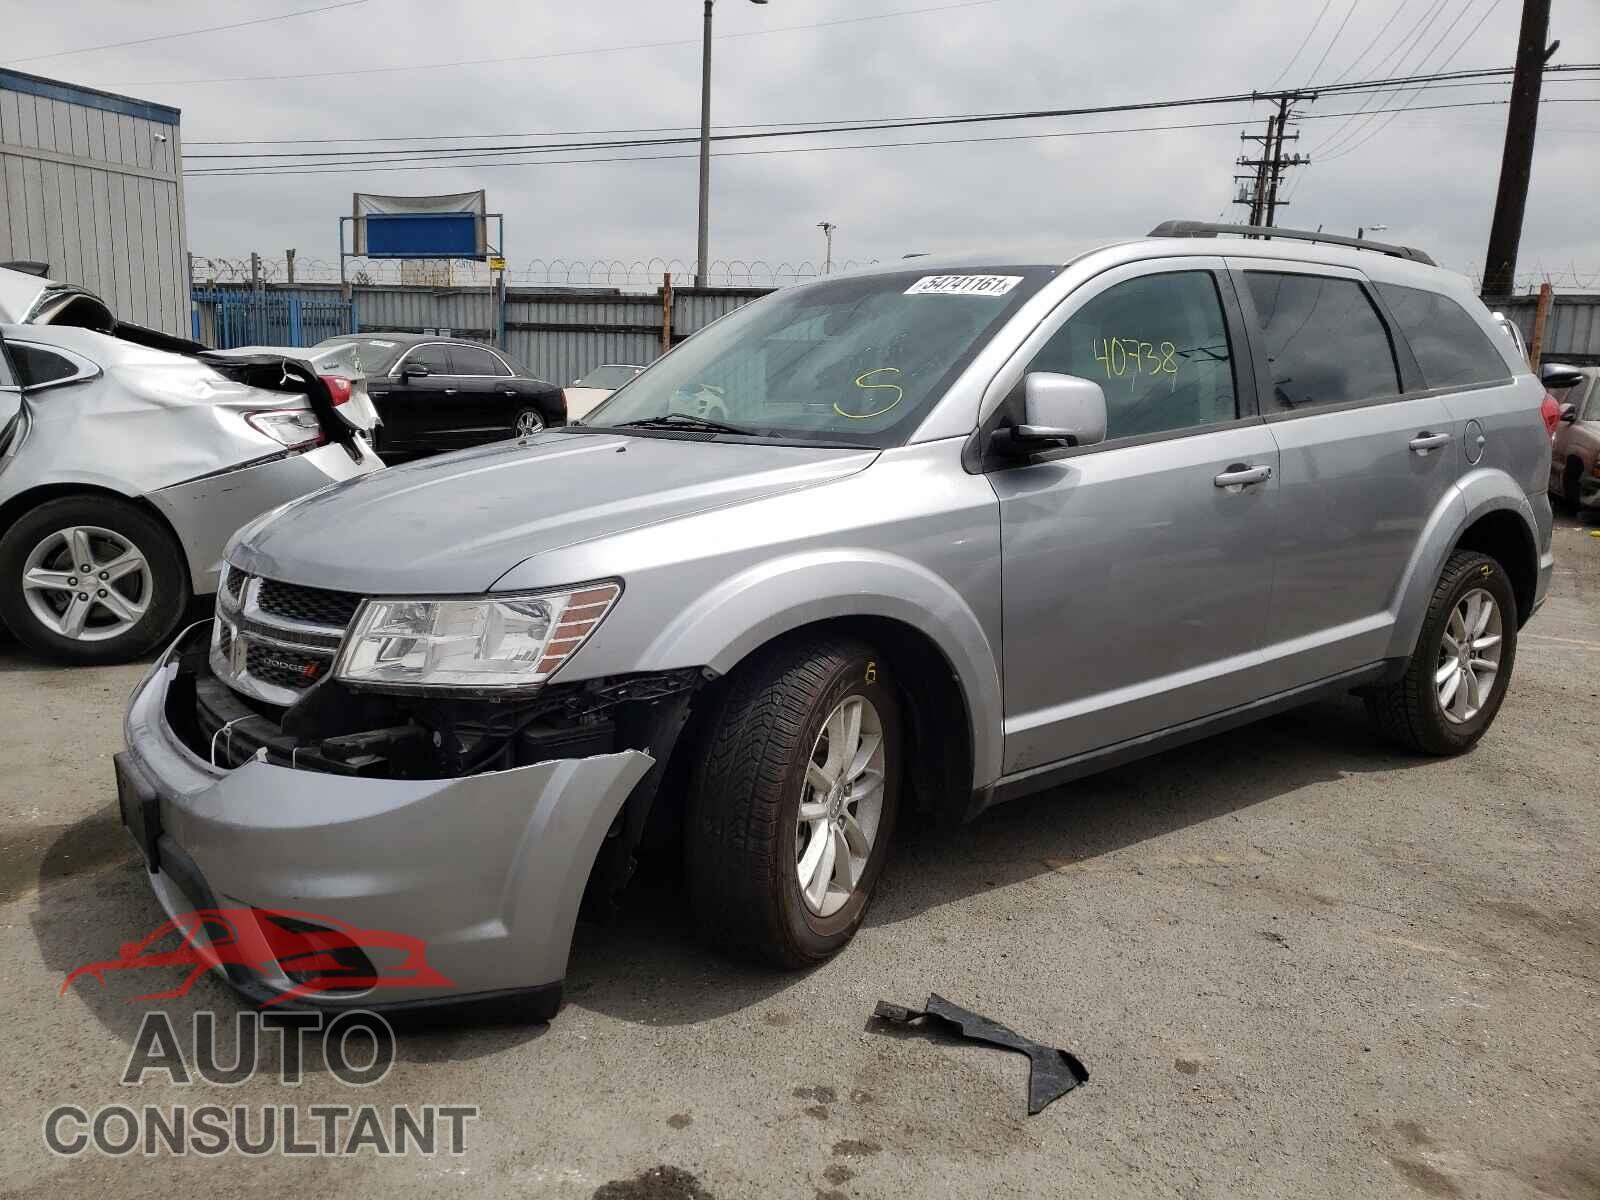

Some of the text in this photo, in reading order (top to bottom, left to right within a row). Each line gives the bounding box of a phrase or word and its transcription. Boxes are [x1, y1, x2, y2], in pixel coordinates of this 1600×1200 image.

[1093, 337, 1178, 379] 40738
[833, 367, 903, 419] S
[264, 657, 304, 672] DODGE
